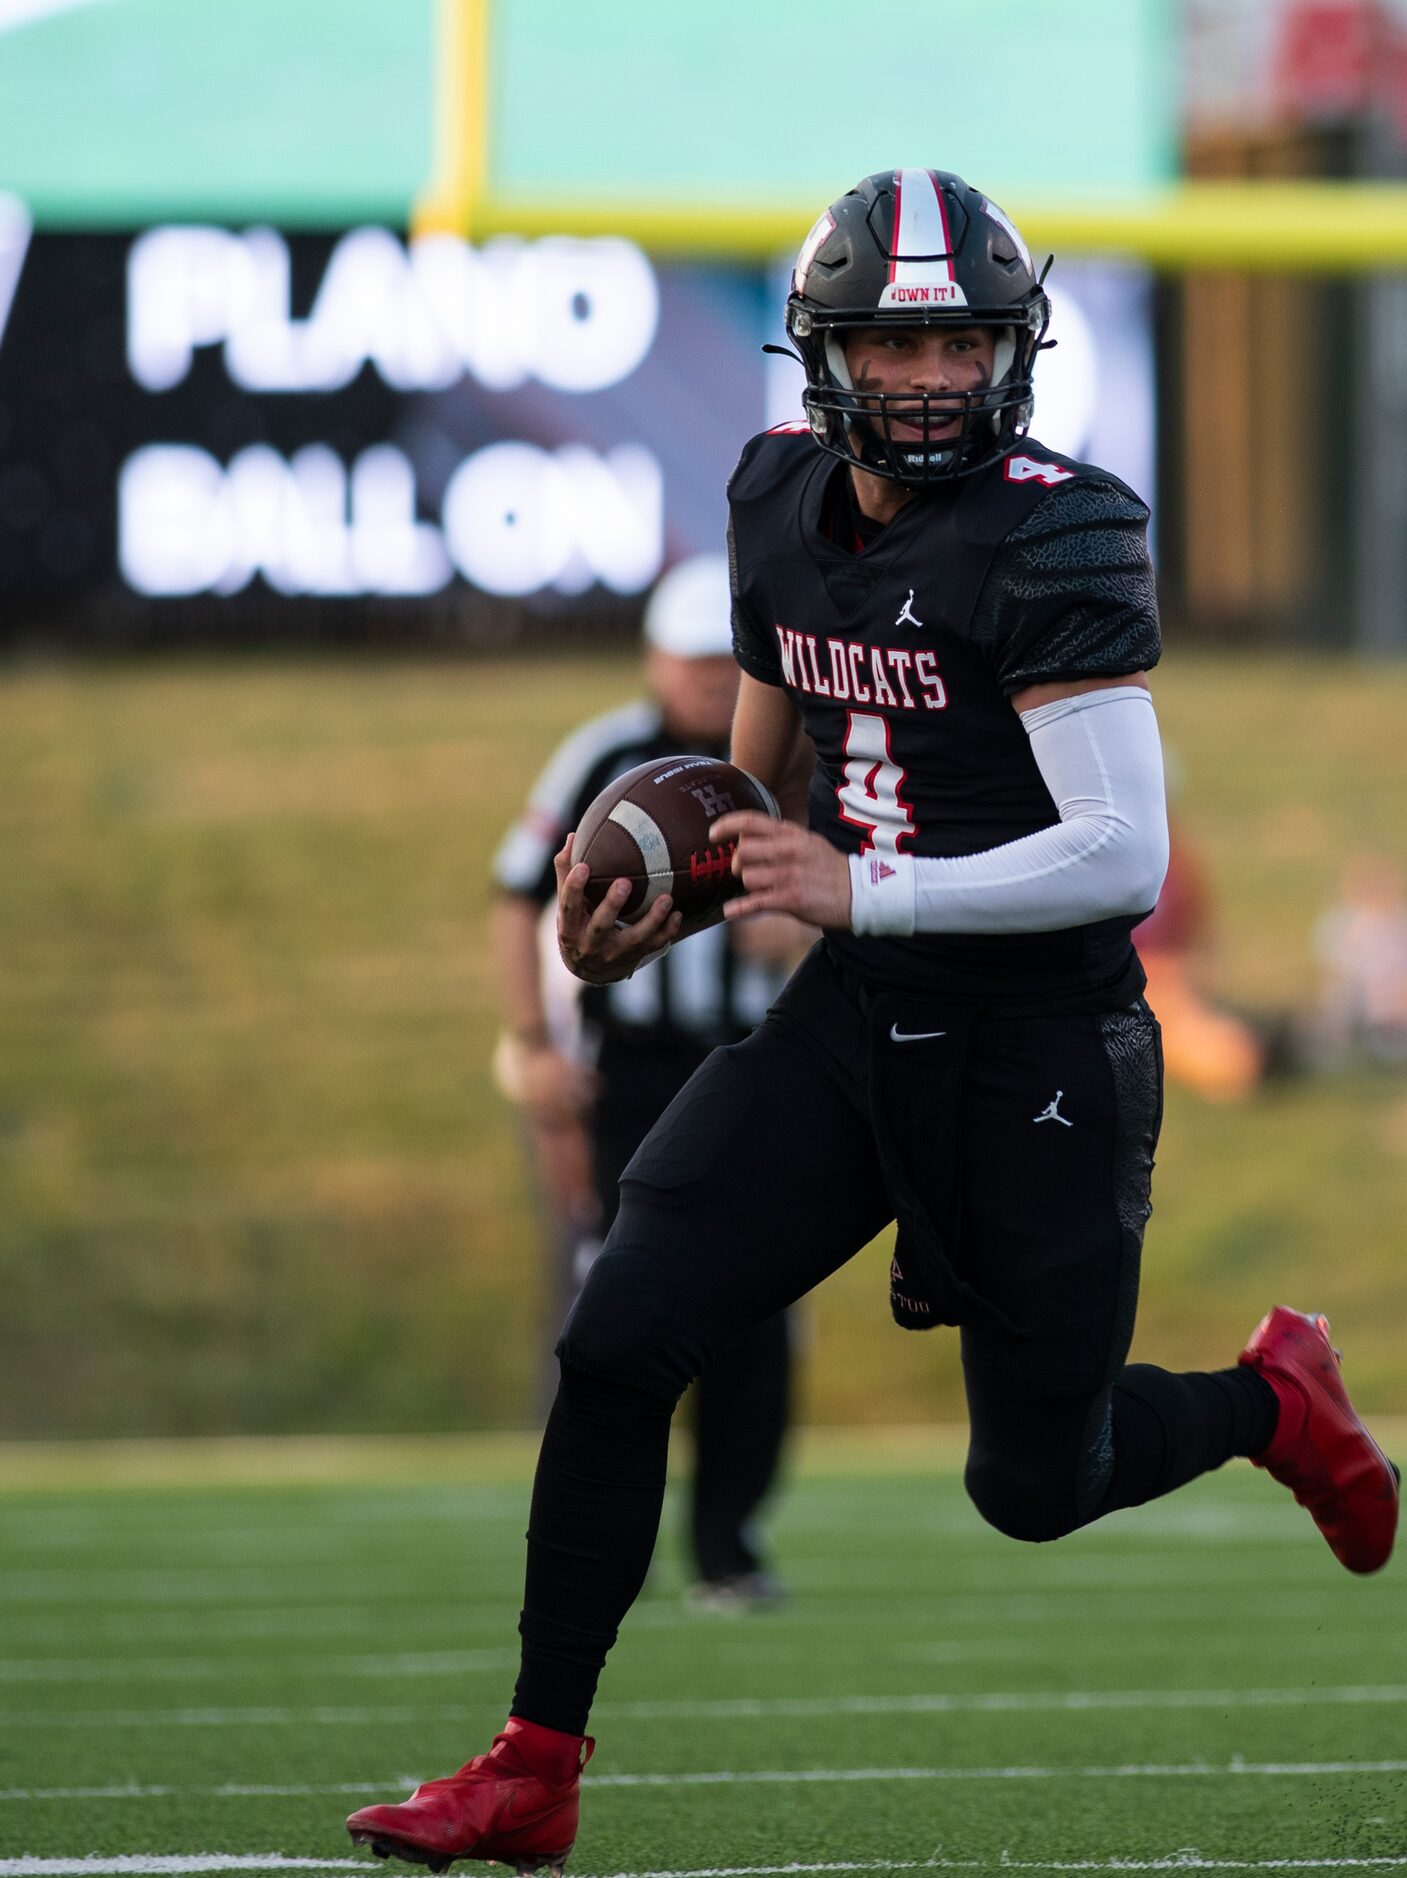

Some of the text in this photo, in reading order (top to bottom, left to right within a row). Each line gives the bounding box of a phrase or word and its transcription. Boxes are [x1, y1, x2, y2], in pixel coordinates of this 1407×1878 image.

[126, 225, 658, 392] PLANO
[898, 287, 930, 302] OWN
[907, 453, 942, 463] Ridell
[1003, 453, 1077, 487] 4
[118, 440, 662, 597] BALL ON
[775, 623, 948, 710] WILDCATS
[835, 708, 919, 857] 4
